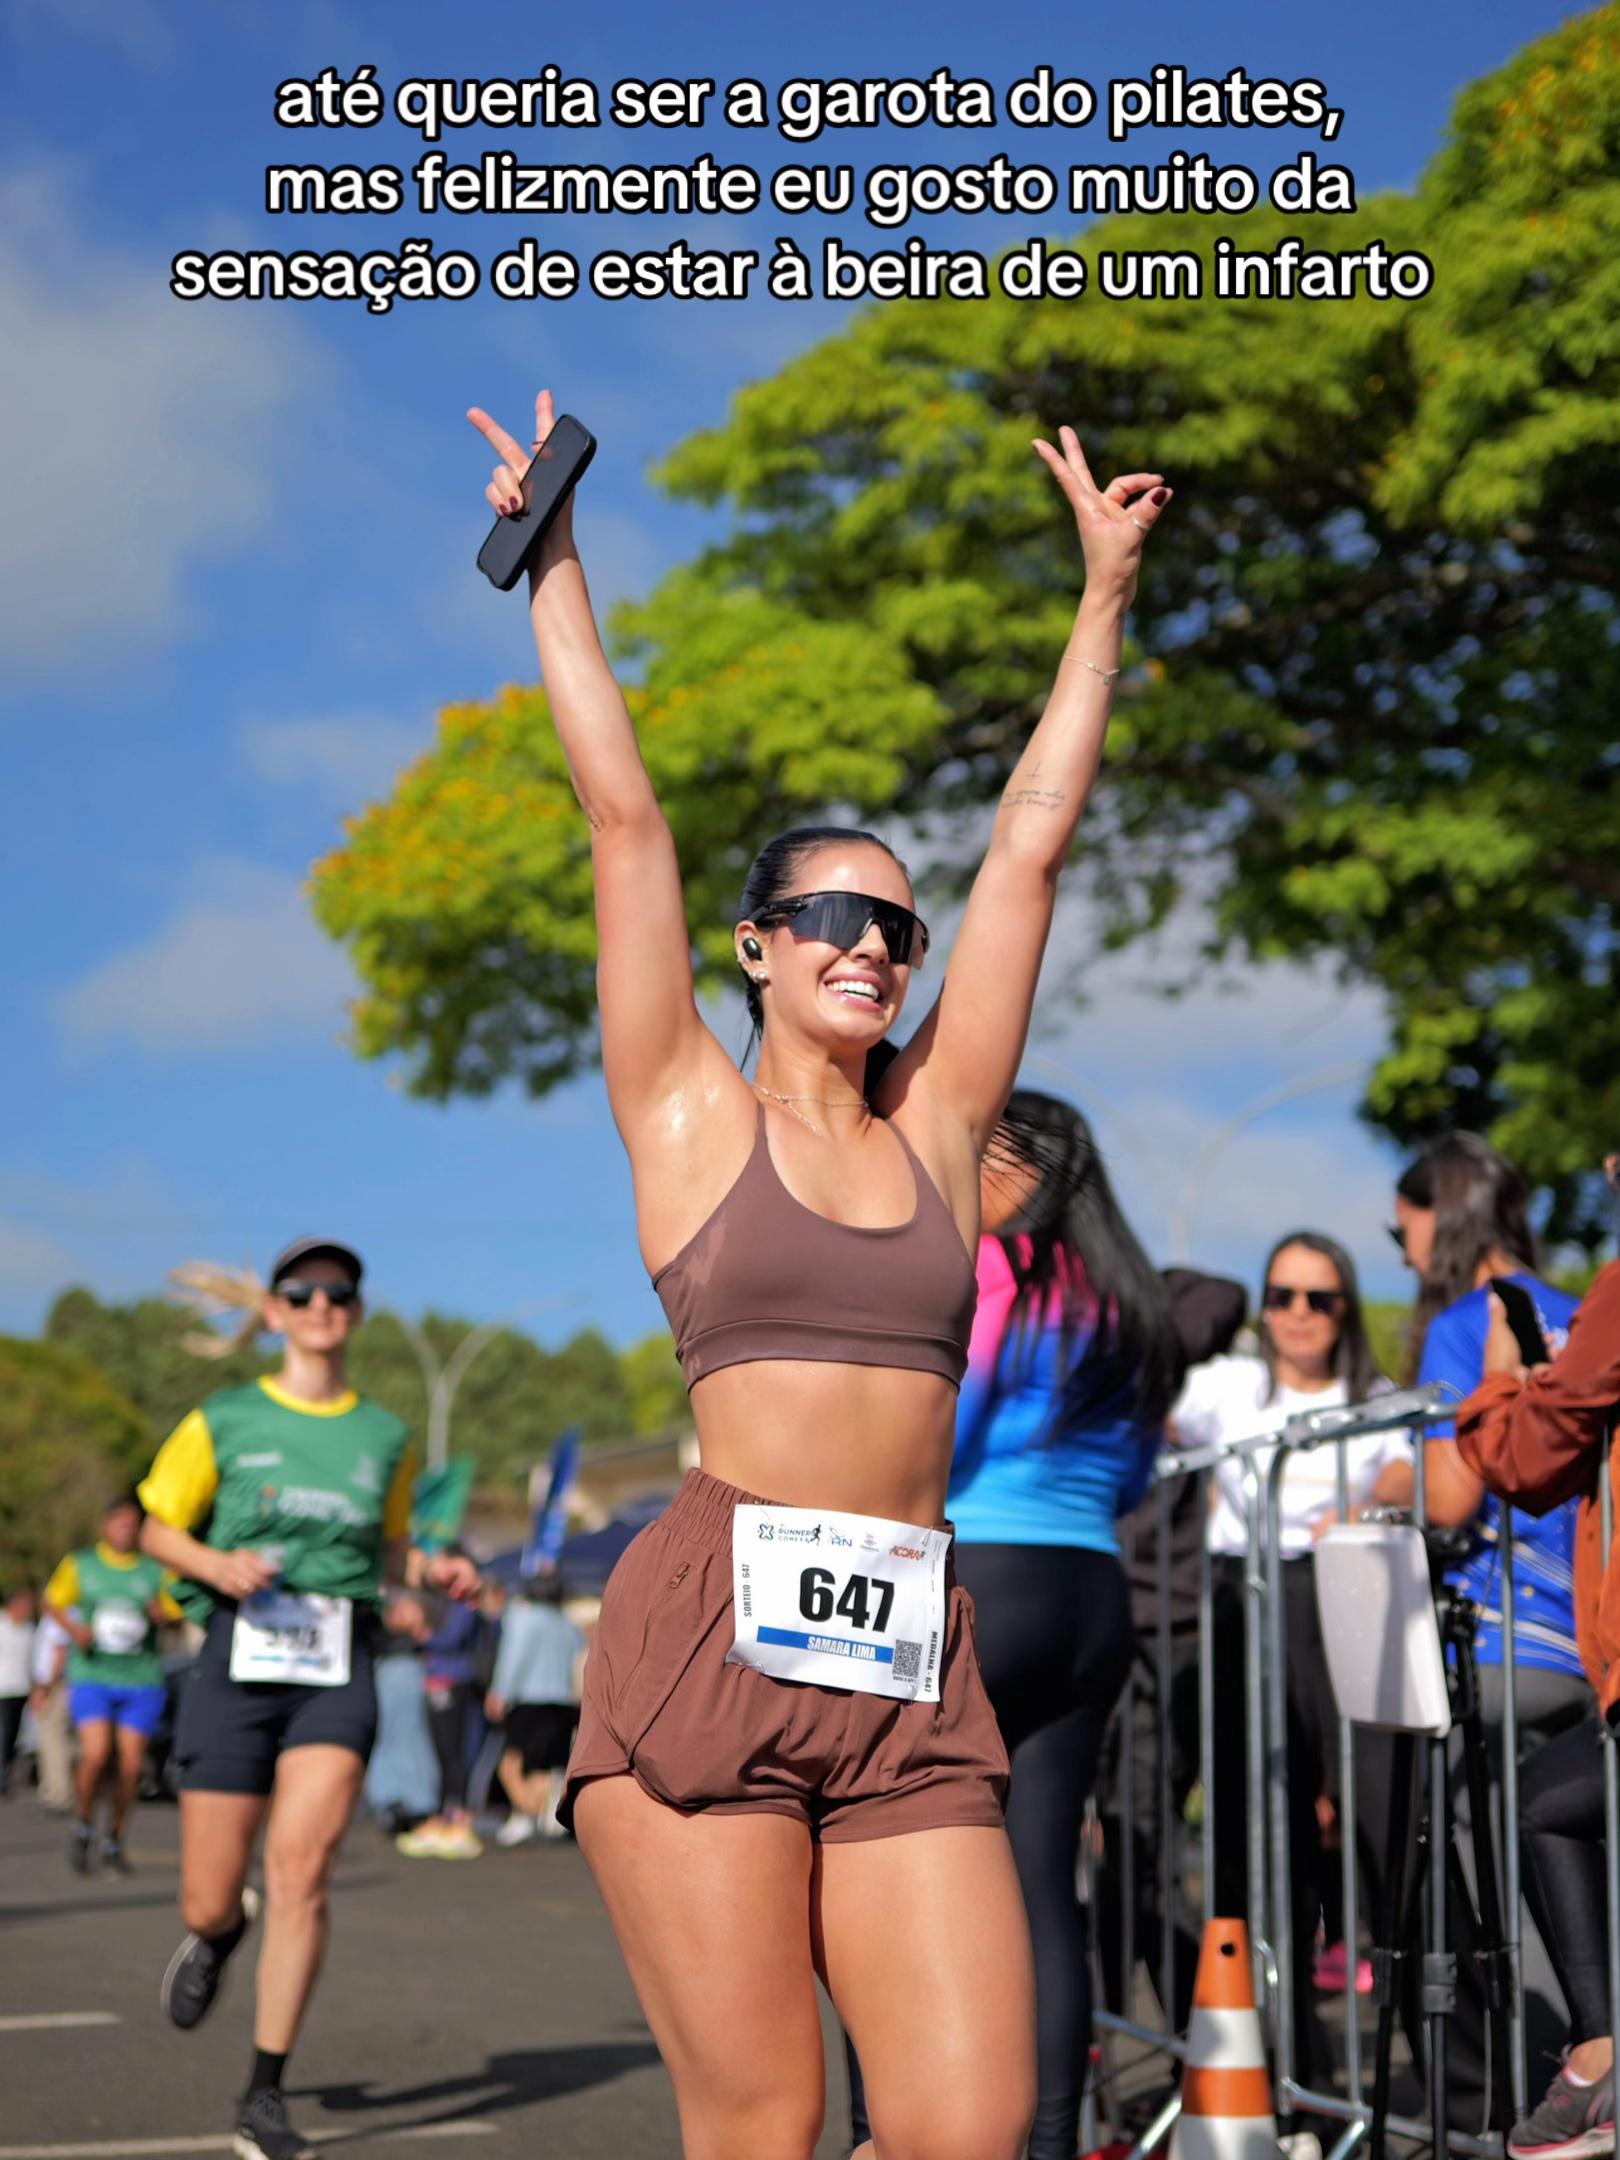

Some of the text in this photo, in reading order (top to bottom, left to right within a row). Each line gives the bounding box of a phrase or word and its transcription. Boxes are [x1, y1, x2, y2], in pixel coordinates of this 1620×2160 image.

[741, 1563, 751, 1579] 647
[742, 1584, 752, 1617] SORTEIO
[798, 1566, 896, 1634] 647
[806, 1635, 877, 1661] SAMARA LIMA
[927, 1631, 938, 1671] MEDALHA
[923, 1677, 933, 1693] 647
